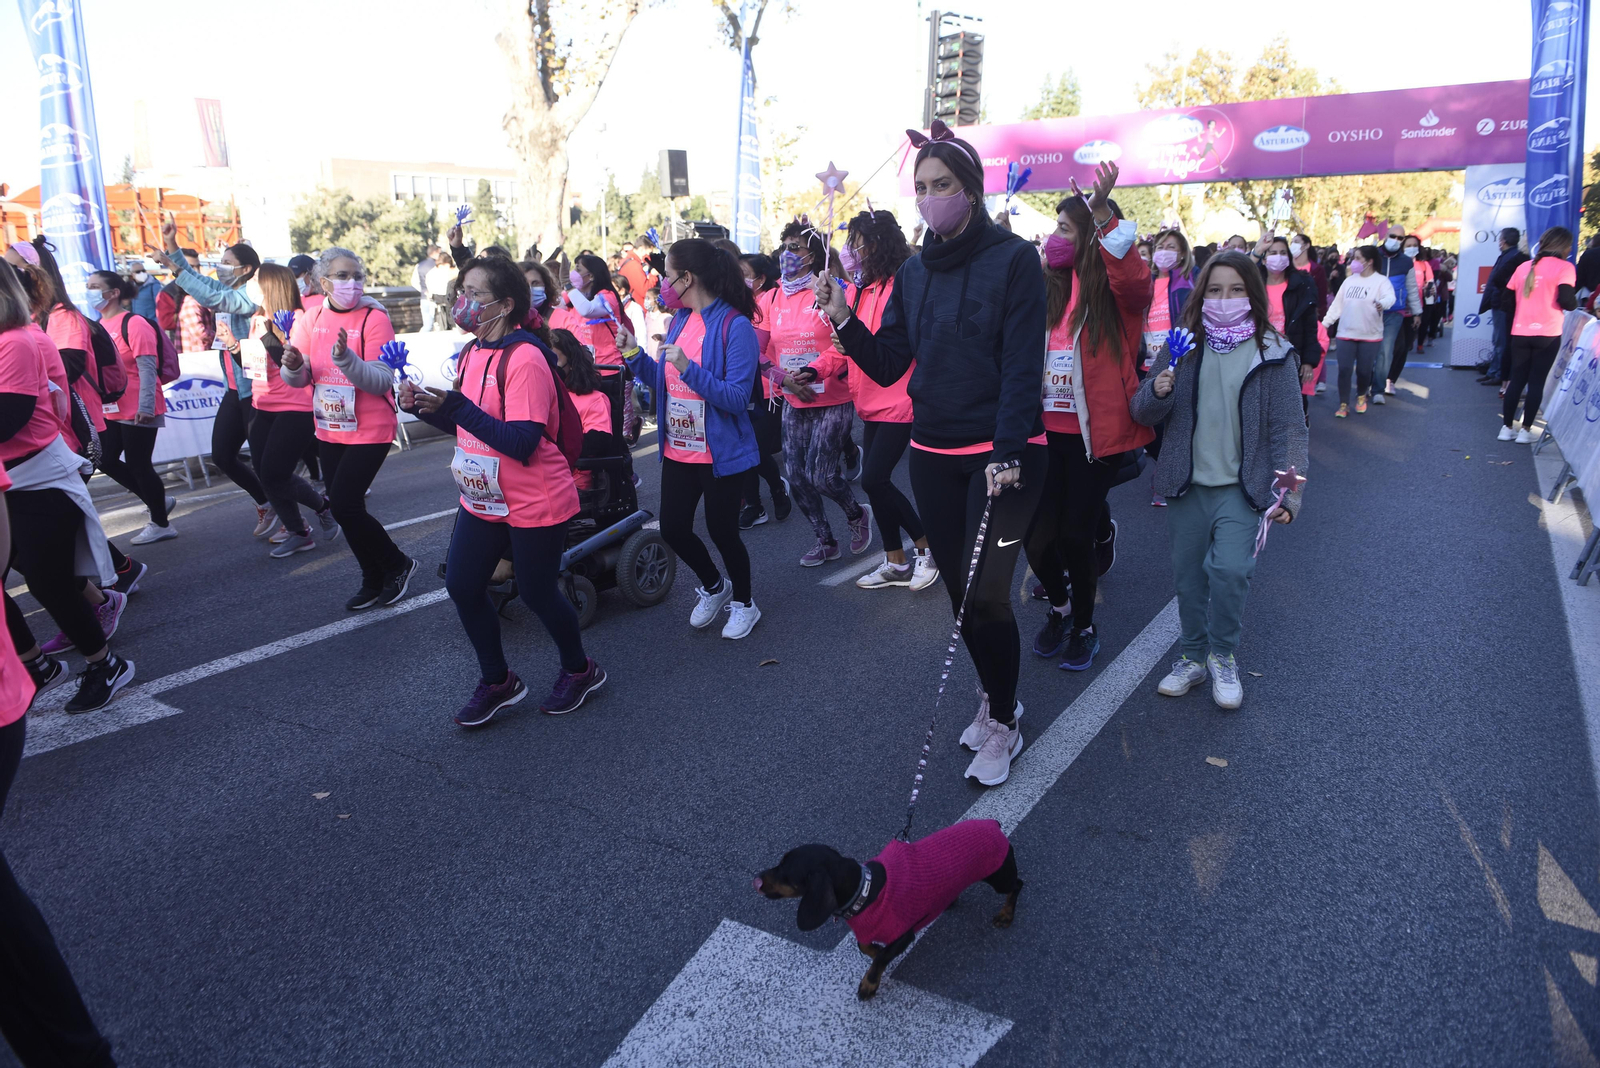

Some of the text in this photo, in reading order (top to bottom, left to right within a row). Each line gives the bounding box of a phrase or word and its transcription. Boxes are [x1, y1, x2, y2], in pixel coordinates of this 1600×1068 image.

[1500, 119, 1528, 131] ZUR
[1327, 128, 1383, 143] OYSHO
[1401, 127, 1457, 139] Santander
[1258, 136, 1306, 146] ASTURIANA
[981, 157, 1007, 167] URICH
[1020, 152, 1063, 166] OYSHO
[1346, 286, 1370, 299] GIRLS
[165, 396, 222, 412] ASTURIA
[324, 402, 341, 412] 016
[670, 416, 690, 429] 016
[463, 476, 484, 491] 016
